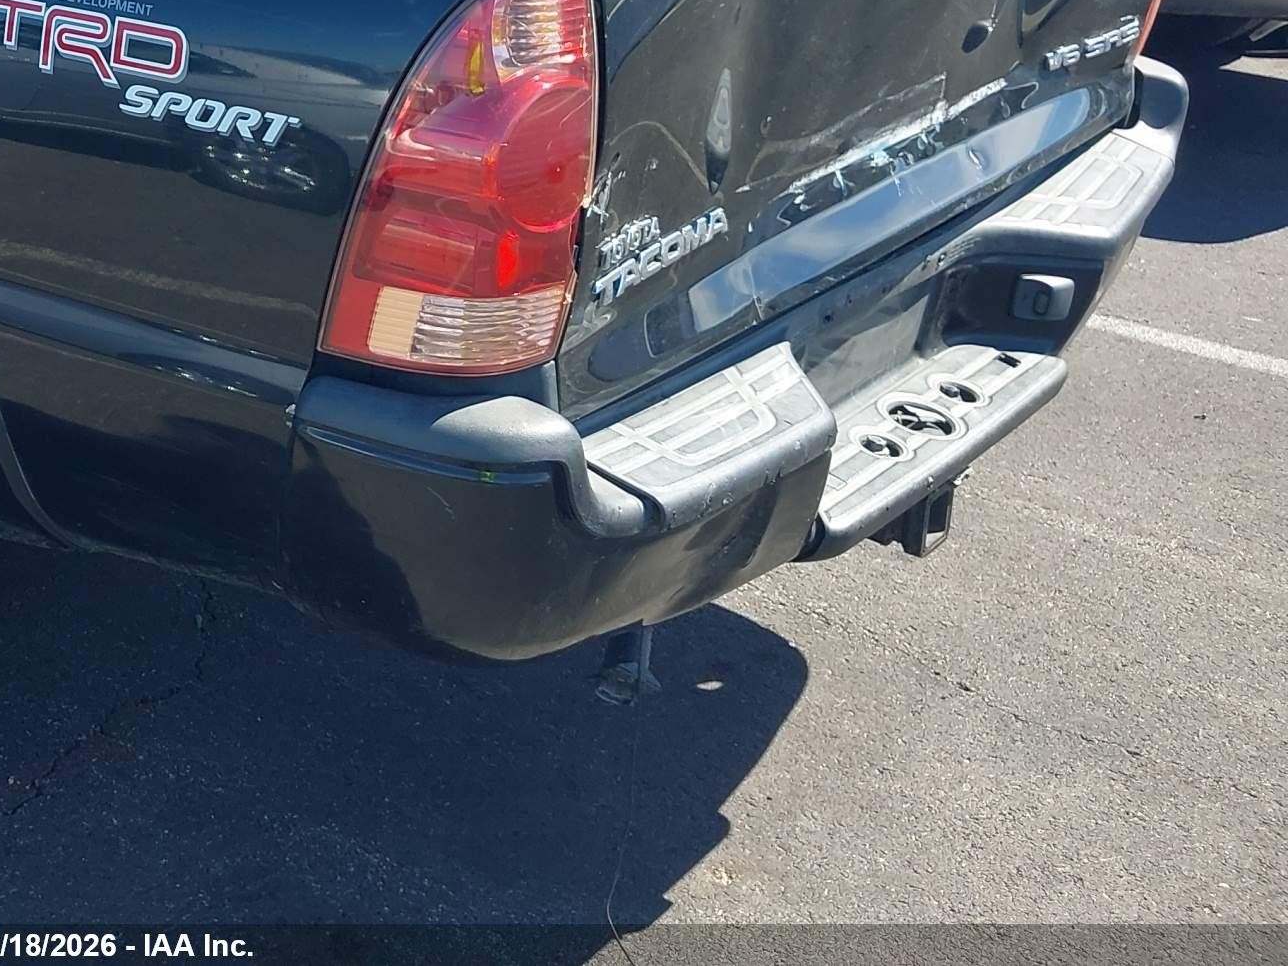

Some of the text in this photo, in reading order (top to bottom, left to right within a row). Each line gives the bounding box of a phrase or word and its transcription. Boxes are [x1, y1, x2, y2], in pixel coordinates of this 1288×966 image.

[1045, 43, 1081, 71] V6
[119, 84, 303, 148] SPORT
[592, 206, 729, 307] TACOMA
[595, 214, 661, 270] TOYOTA
